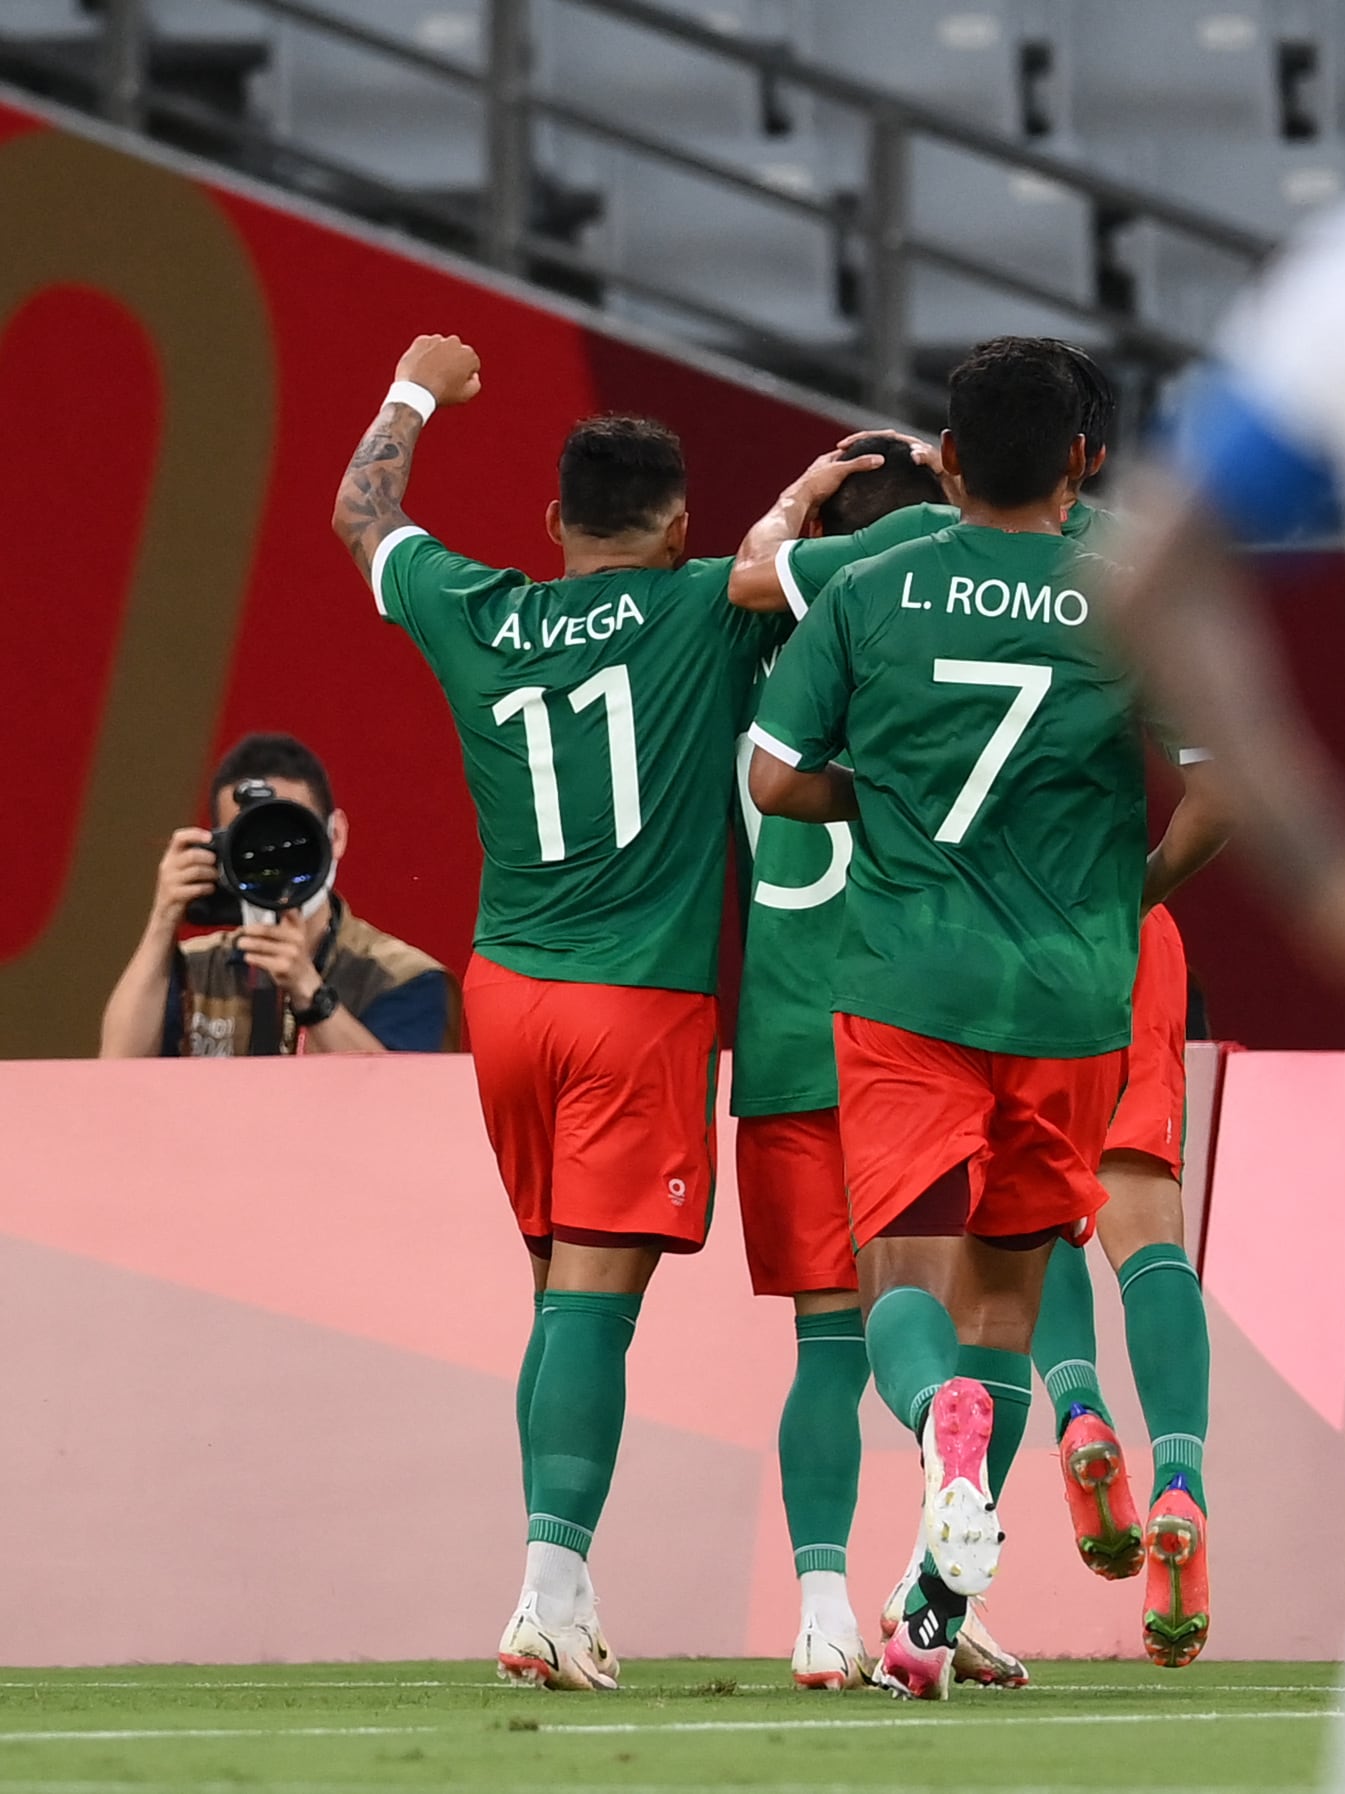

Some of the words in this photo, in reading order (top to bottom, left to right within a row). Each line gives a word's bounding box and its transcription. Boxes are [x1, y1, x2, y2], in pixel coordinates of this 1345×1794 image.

[491, 612, 532, 651] A.
[541, 593, 645, 649] VEGA
[901, 572, 932, 610] L.
[946, 576, 1089, 626] ROMO
[492, 664, 642, 862] 11
[933, 658, 1053, 844] 7
